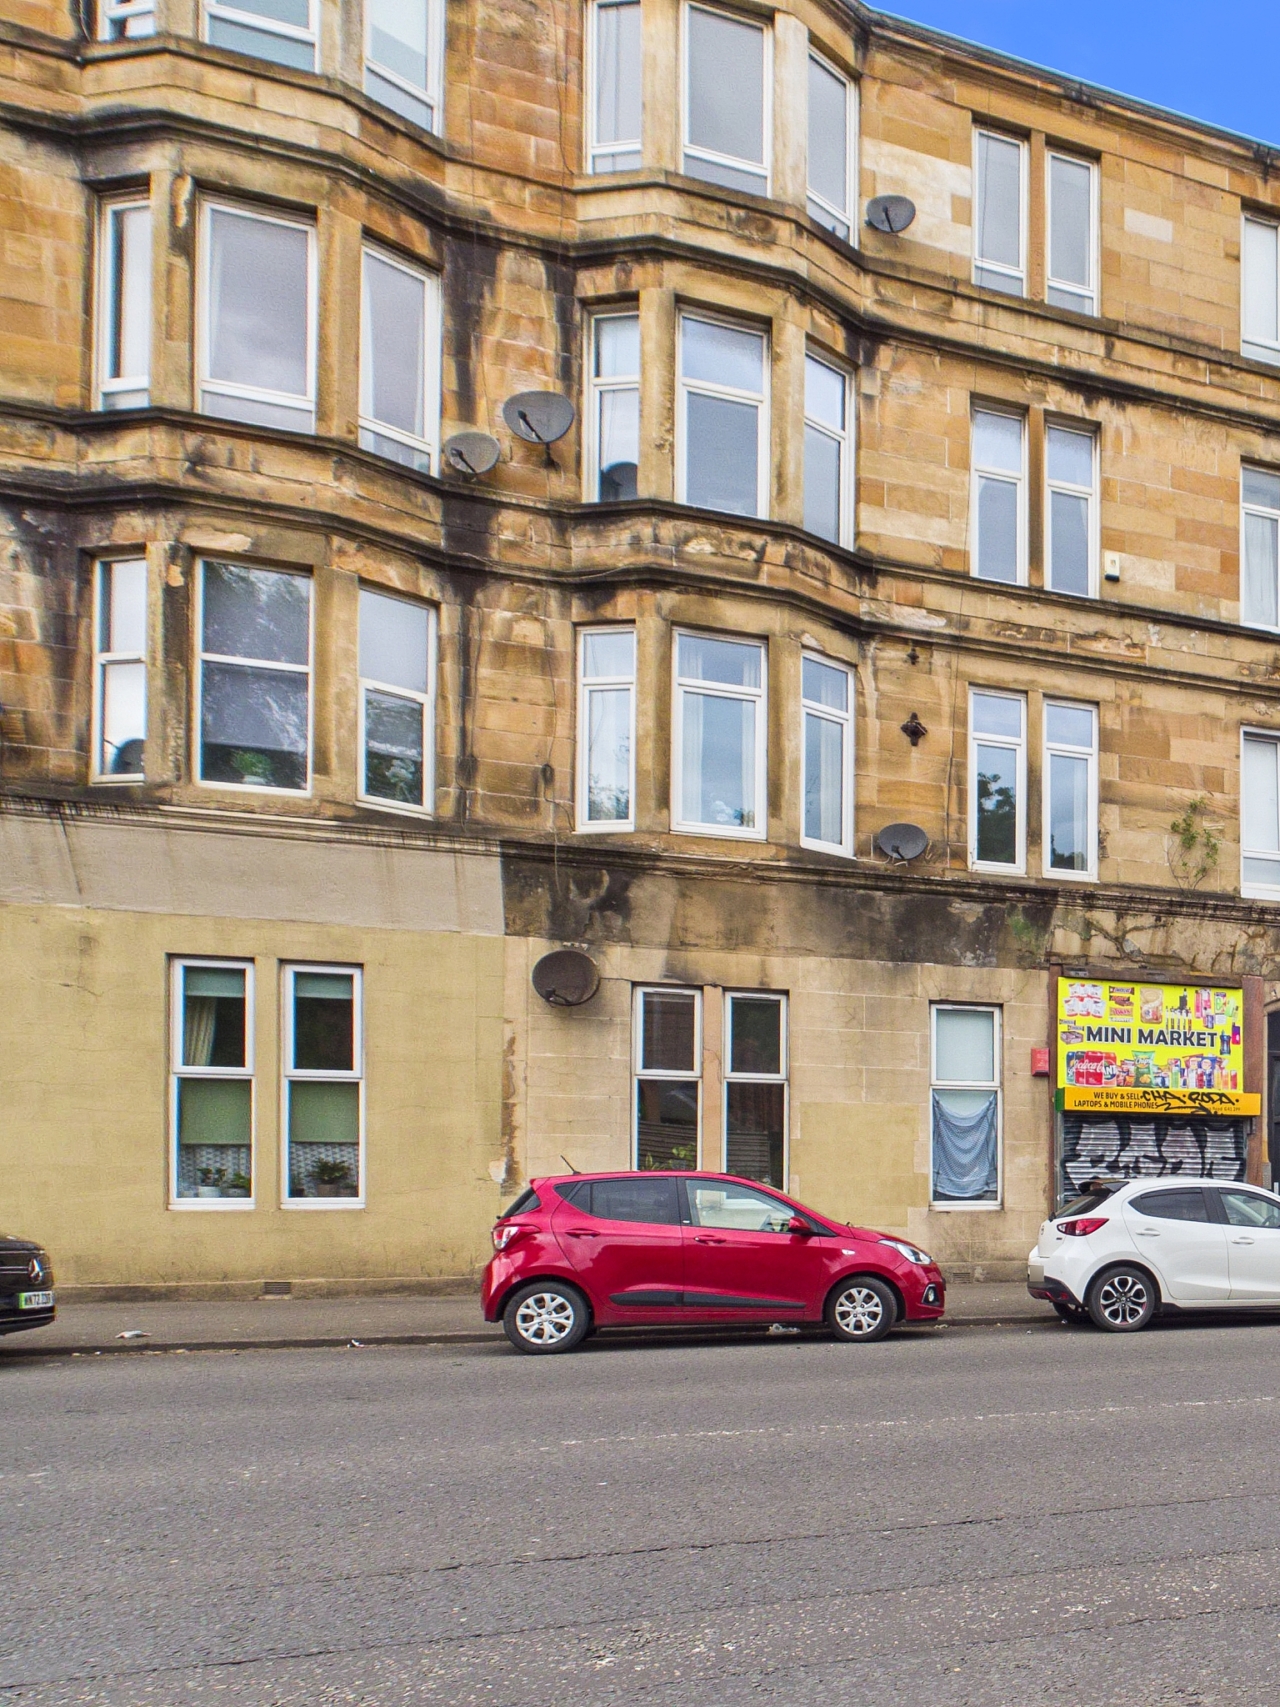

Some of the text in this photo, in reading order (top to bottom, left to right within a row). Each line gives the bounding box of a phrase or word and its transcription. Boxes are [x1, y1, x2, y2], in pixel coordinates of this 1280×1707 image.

[1086, 1025, 1217, 1047] MINI MARKET
[1074, 1100, 1102, 1108] LAPTOPS
